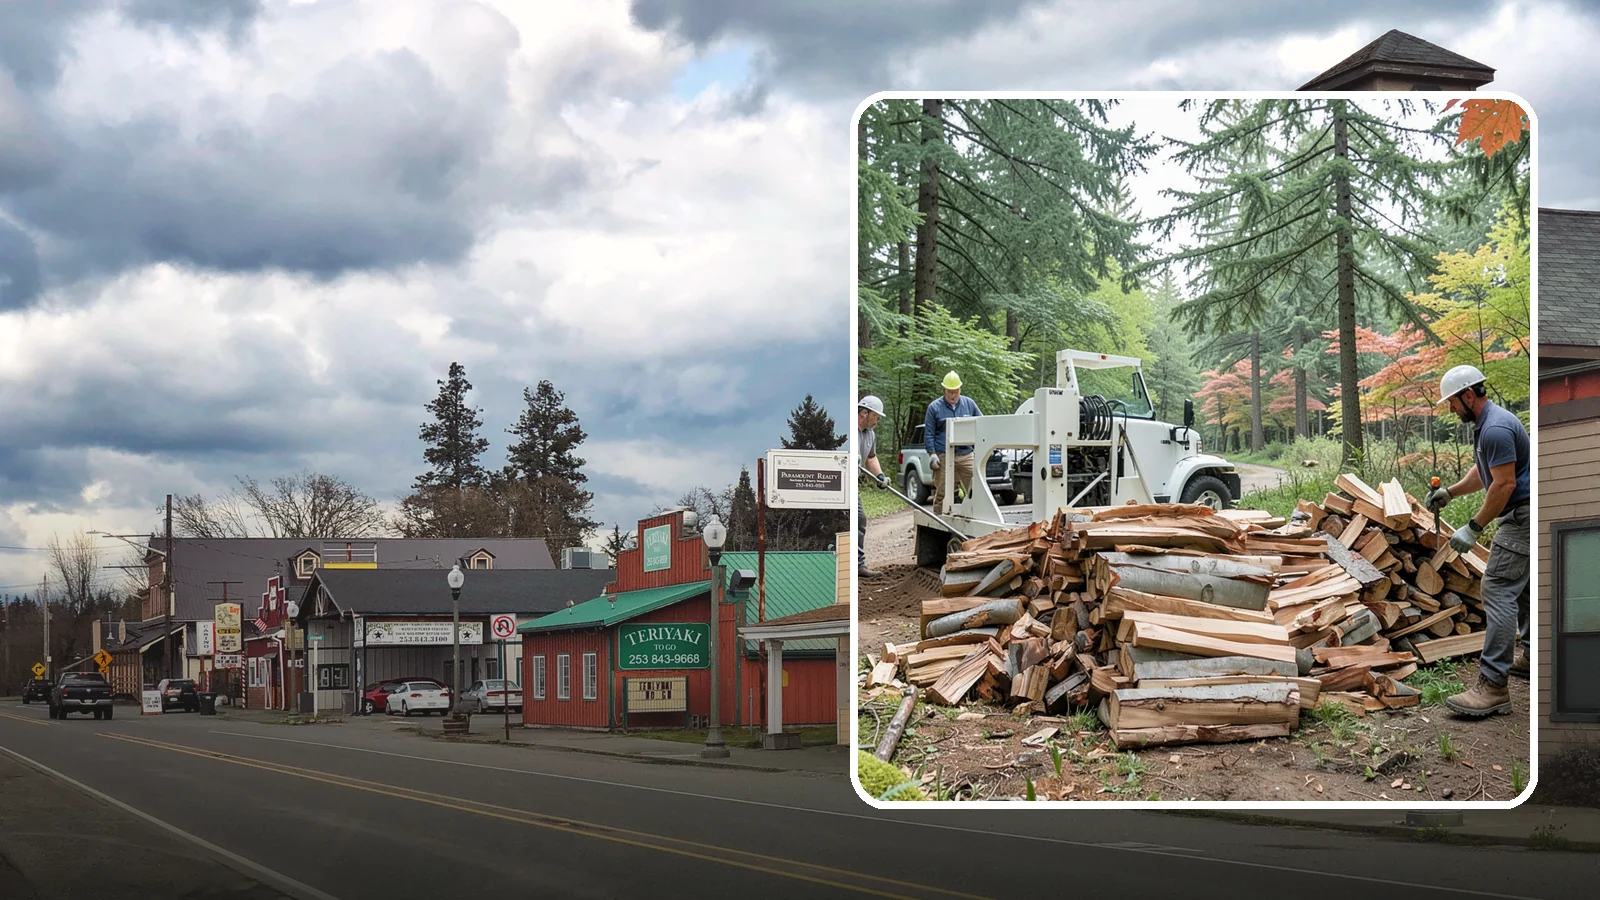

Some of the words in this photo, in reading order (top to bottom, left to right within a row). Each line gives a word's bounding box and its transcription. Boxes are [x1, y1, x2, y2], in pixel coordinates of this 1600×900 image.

[817, 472, 839, 480] REALTY
[625, 627, 702, 646] TERIYAKI
[629, 654, 648, 664] 253
[651, 653, 700, 664] 843-9668
